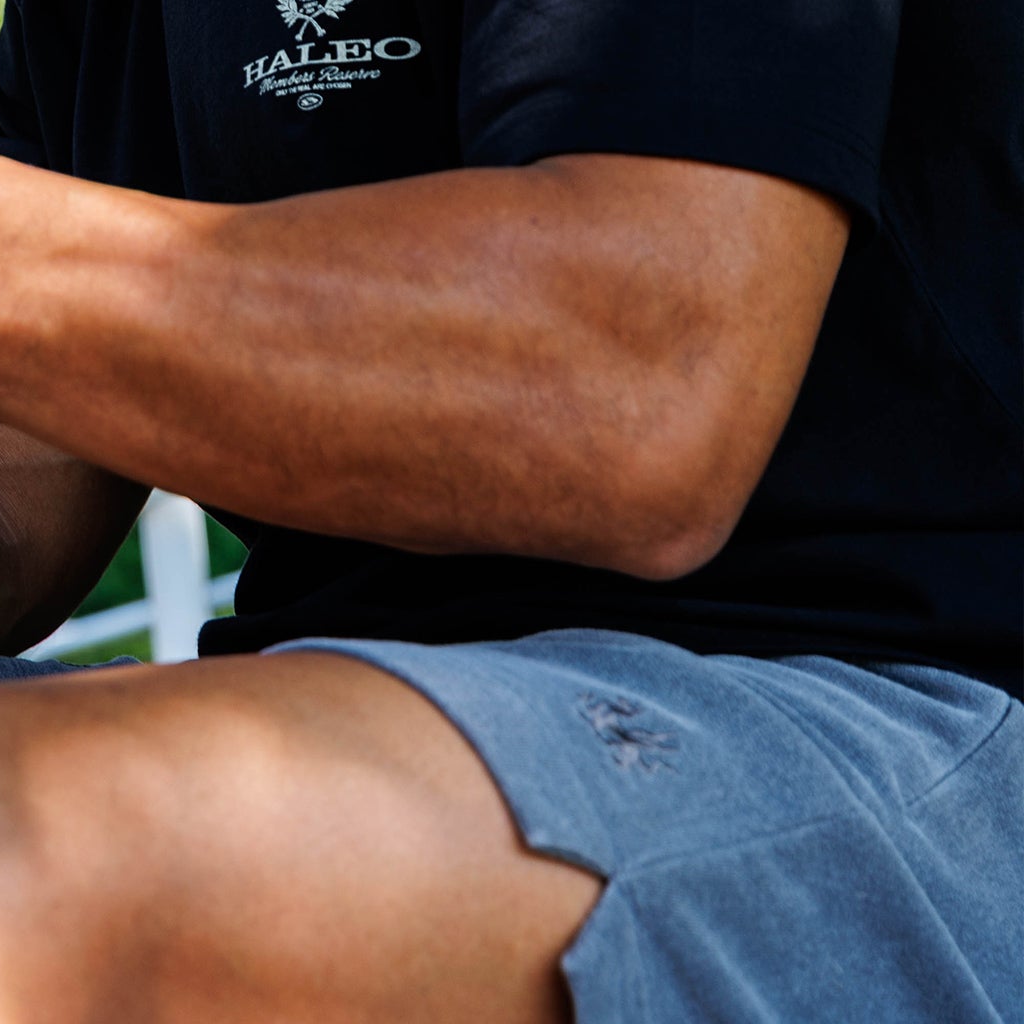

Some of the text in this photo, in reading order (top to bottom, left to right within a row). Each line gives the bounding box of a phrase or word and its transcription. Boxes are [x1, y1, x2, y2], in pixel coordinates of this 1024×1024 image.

[243, 36, 422, 88] HALEO
[259, 65, 381, 96] Members Reserve
